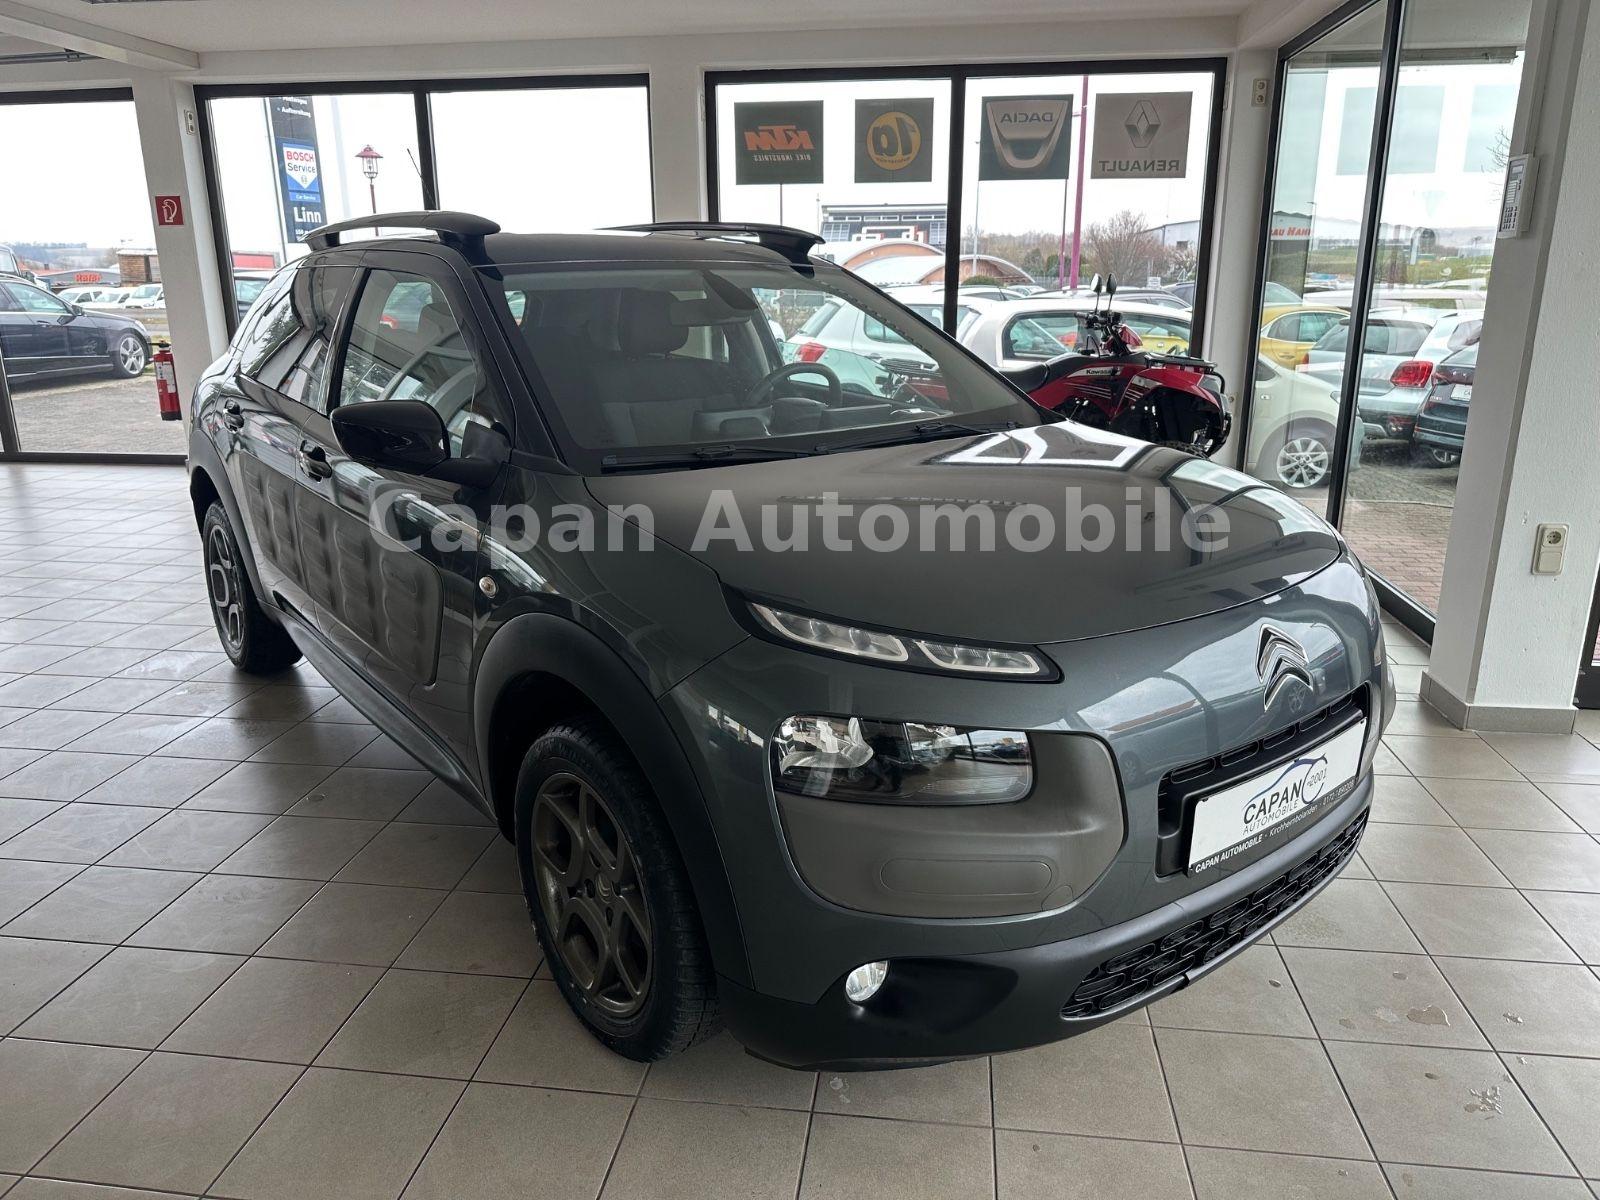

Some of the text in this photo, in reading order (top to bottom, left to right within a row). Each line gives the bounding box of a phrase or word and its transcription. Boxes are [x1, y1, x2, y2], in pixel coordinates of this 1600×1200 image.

[286, 150, 315, 163] BOSCH
[287, 162, 316, 174] Service
[293, 206, 322, 223] Linn
[1243, 779, 1303, 825] CAPAN
[1243, 799, 1299, 836] AUTOMOBILE
[1195, 857, 1220, 874] CAPAN
[1220, 833, 1263, 862] AUTOMOBILE
